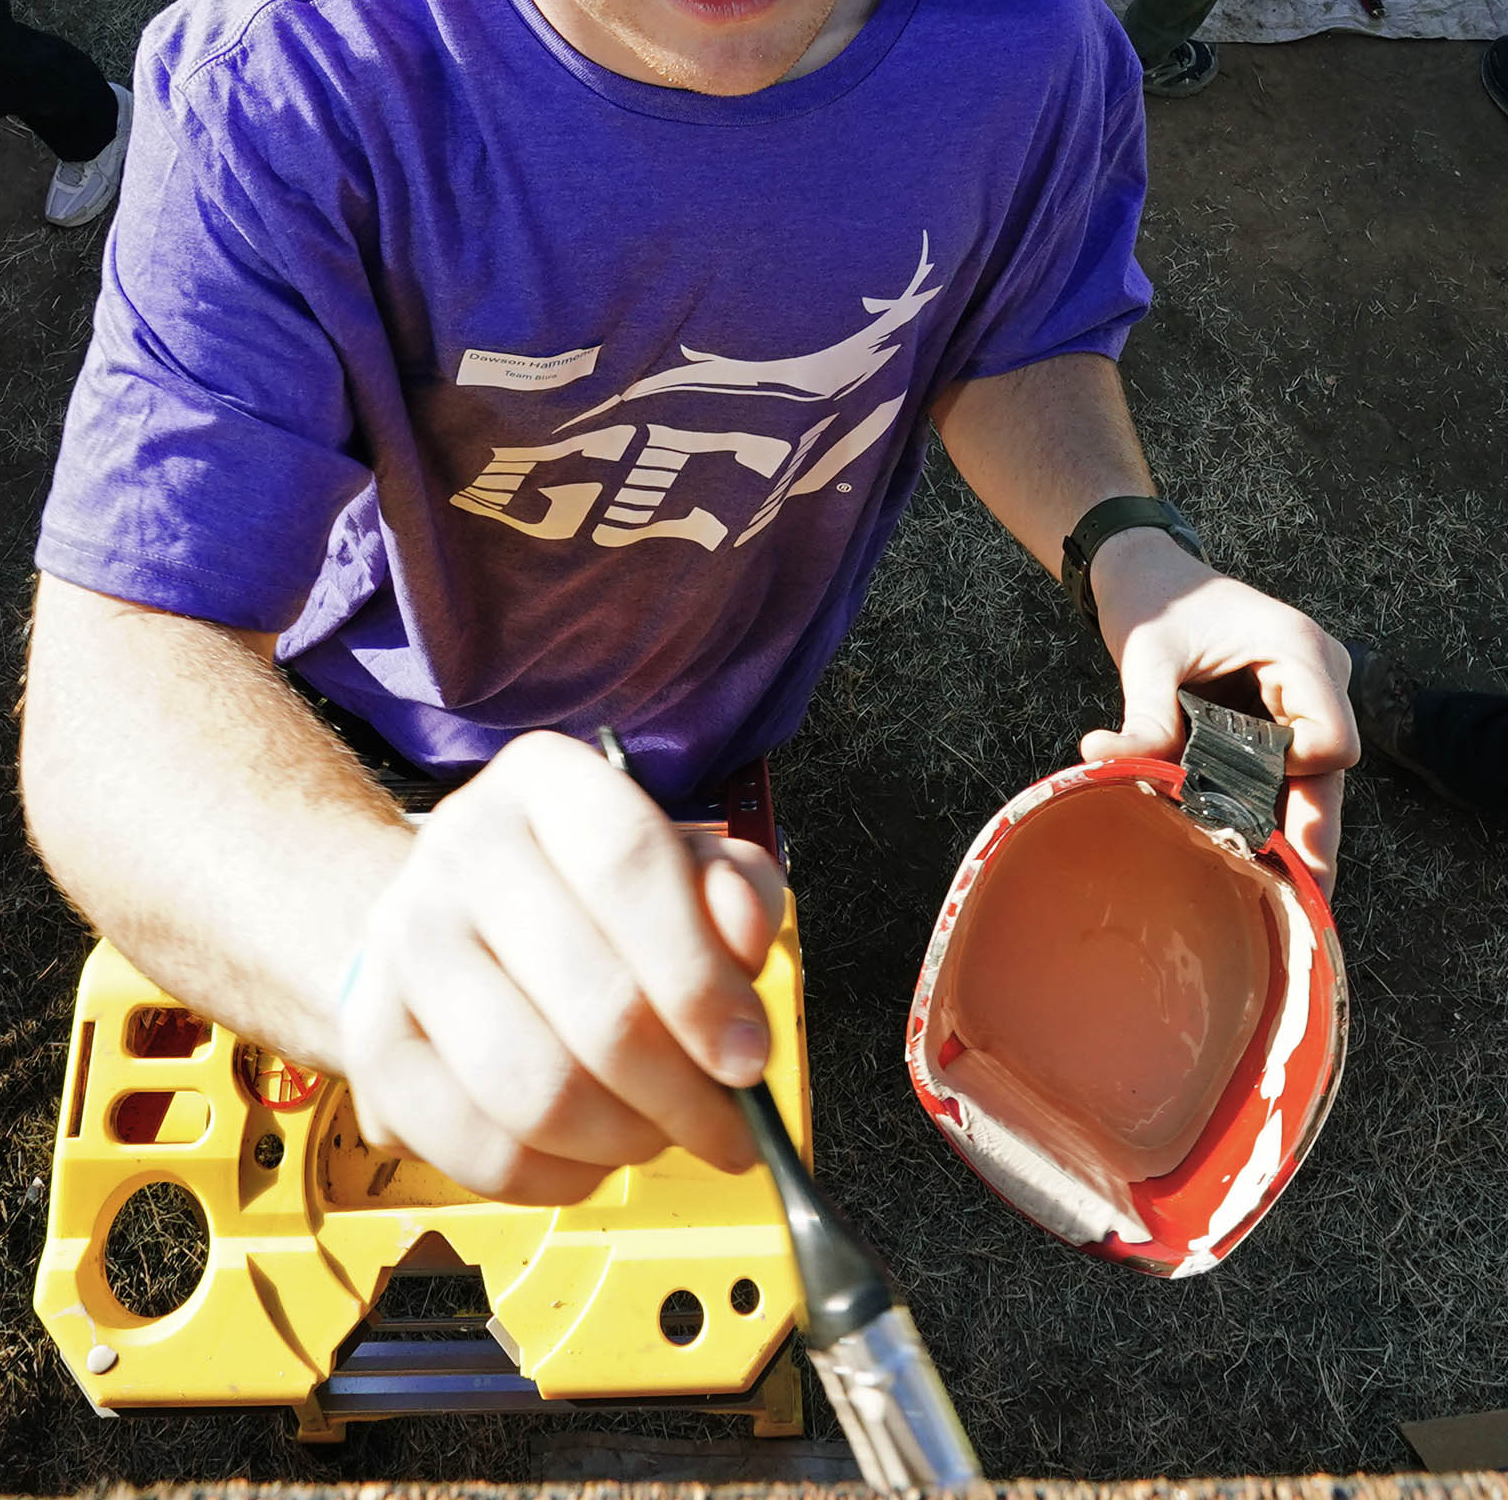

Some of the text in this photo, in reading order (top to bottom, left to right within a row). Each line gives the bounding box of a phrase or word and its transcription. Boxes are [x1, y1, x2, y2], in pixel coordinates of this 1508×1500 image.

[469, 353, 525, 367] Dawson
[504, 370, 558, 381] Team Blue
